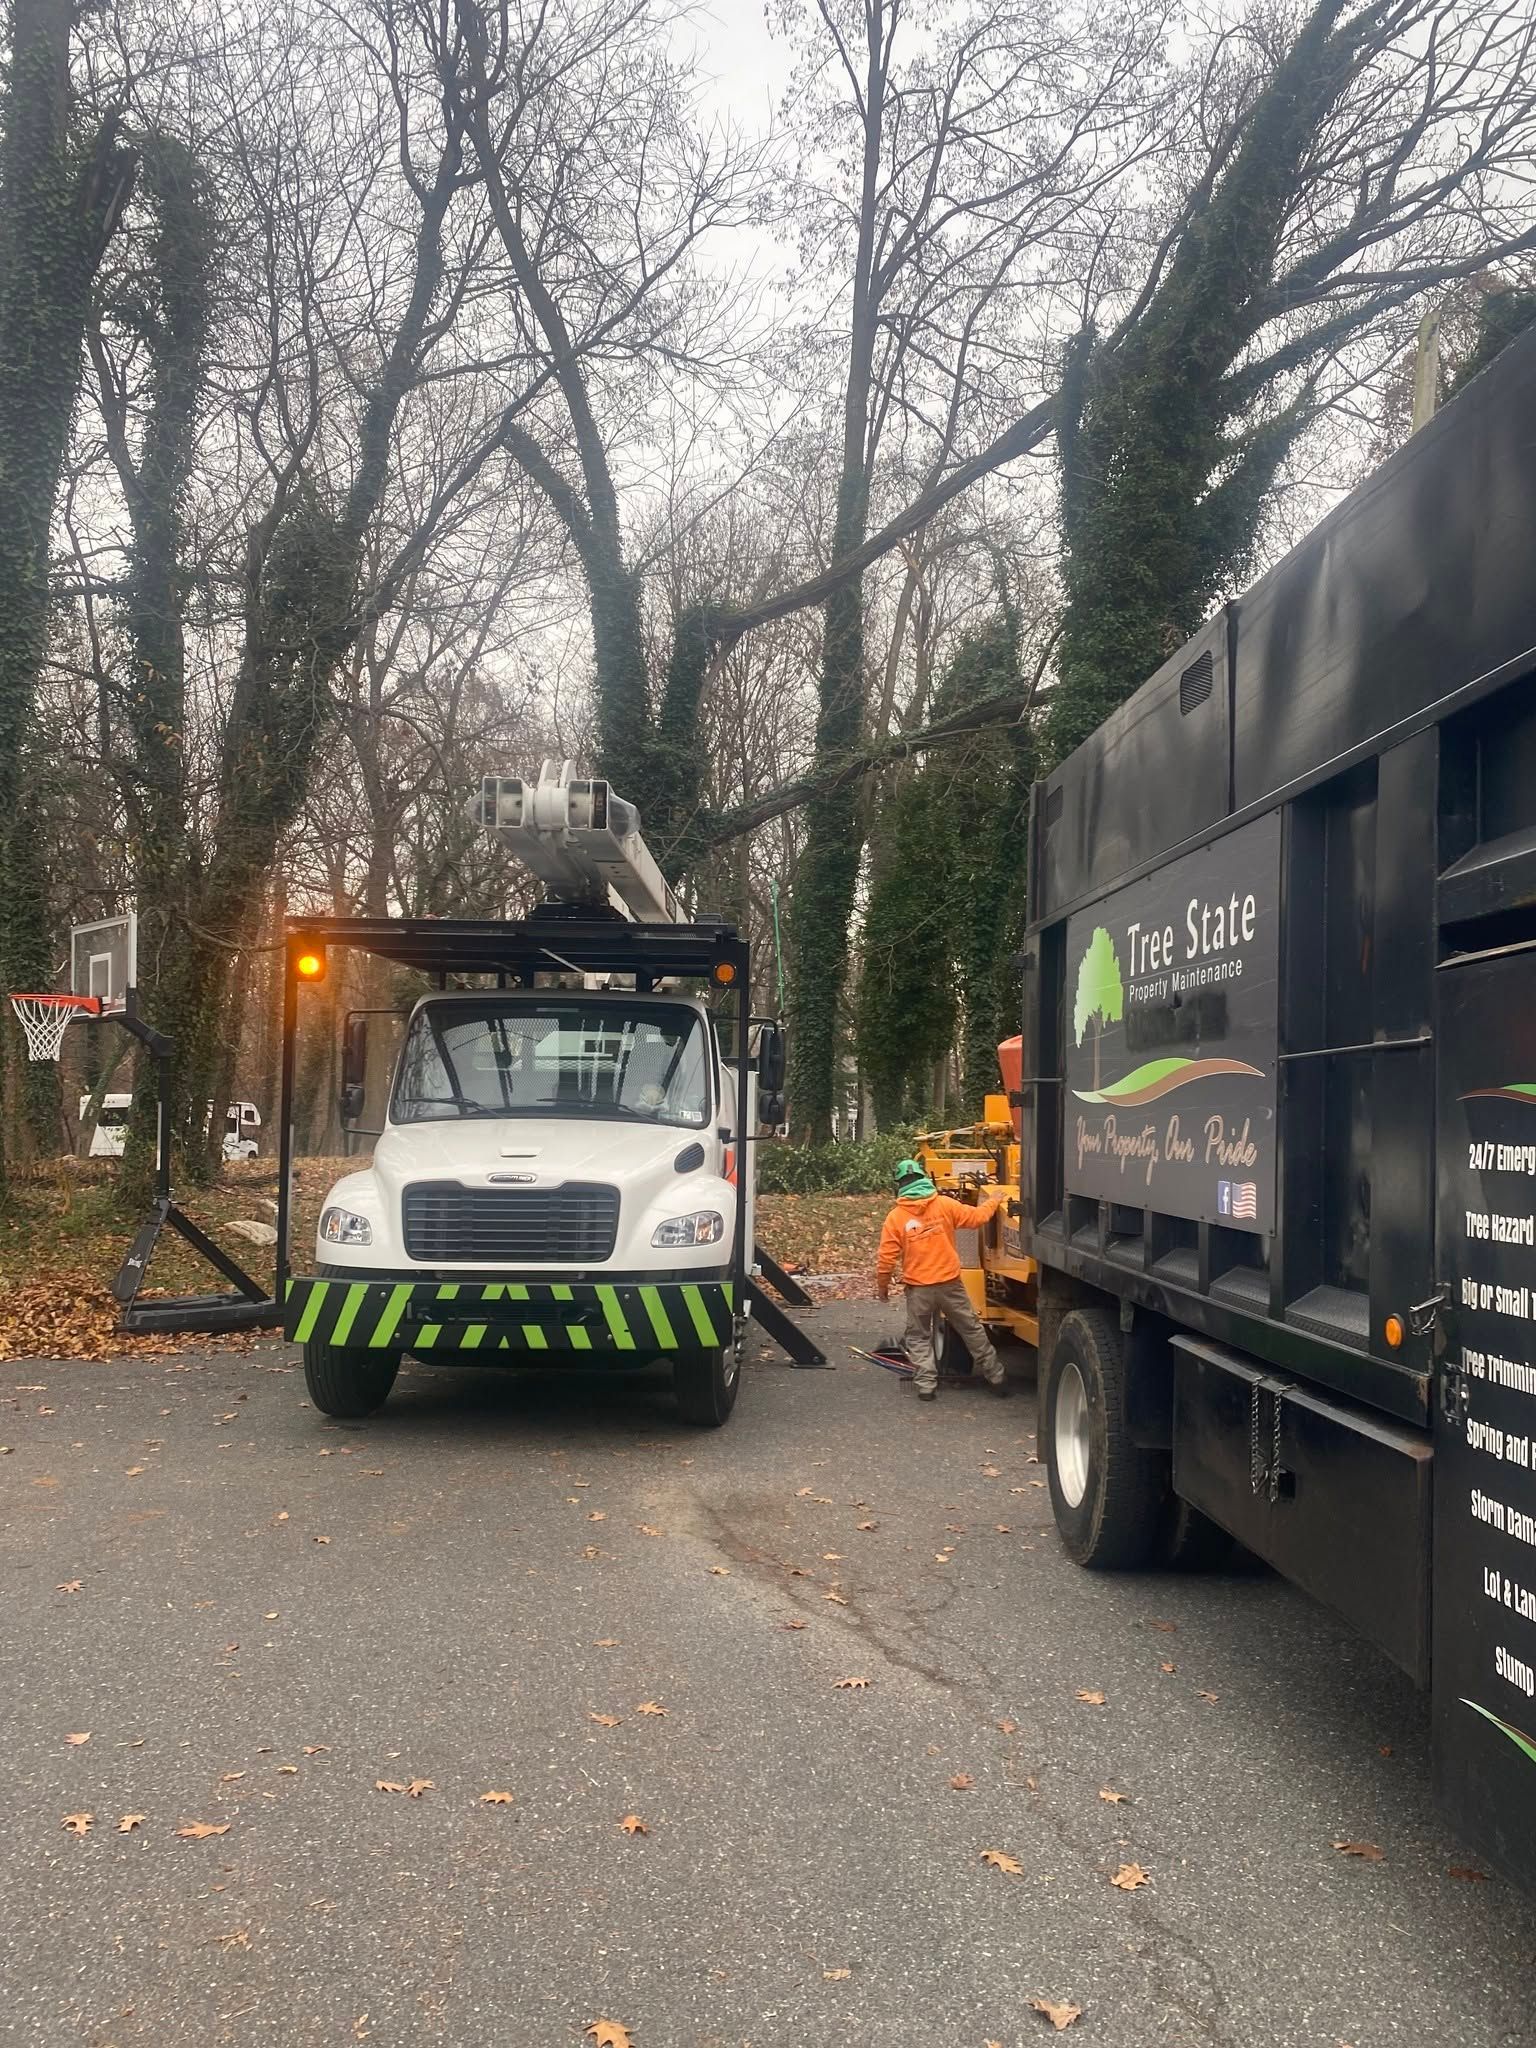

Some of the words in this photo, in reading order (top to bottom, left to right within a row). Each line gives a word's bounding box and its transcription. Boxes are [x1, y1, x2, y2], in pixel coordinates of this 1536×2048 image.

[1127, 922, 1174, 977] Tree
[1186, 891, 1256, 959] State
[1129, 980, 1168, 1004] Property
[1172, 959, 1243, 992] Maintenance
[1076, 1115, 1101, 1171] Your
[1164, 1114, 1195, 1163] Our
[1204, 1114, 1258, 1168] Pride
[1468, 1141, 1496, 1171] 24/7
[1496, 1143, 1536, 1176] Emerg
[1465, 1211, 1490, 1240] Tree
[1491, 1213, 1535, 1246] Hazard
[1461, 1276, 1478, 1310] Big
[1480, 1283, 1494, 1310] or
[1495, 1285, 1529, 1319] Small
[1460, 1346, 1486, 1379] Tree
[1466, 1417, 1503, 1461] Spring
[1505, 1433, 1529, 1468] and
[1471, 1488, 1505, 1531] Storm
[1484, 1566, 1501, 1602] Lot
[1503, 1578, 1512, 1609] &
[1495, 1645, 1535, 1698] Stump
